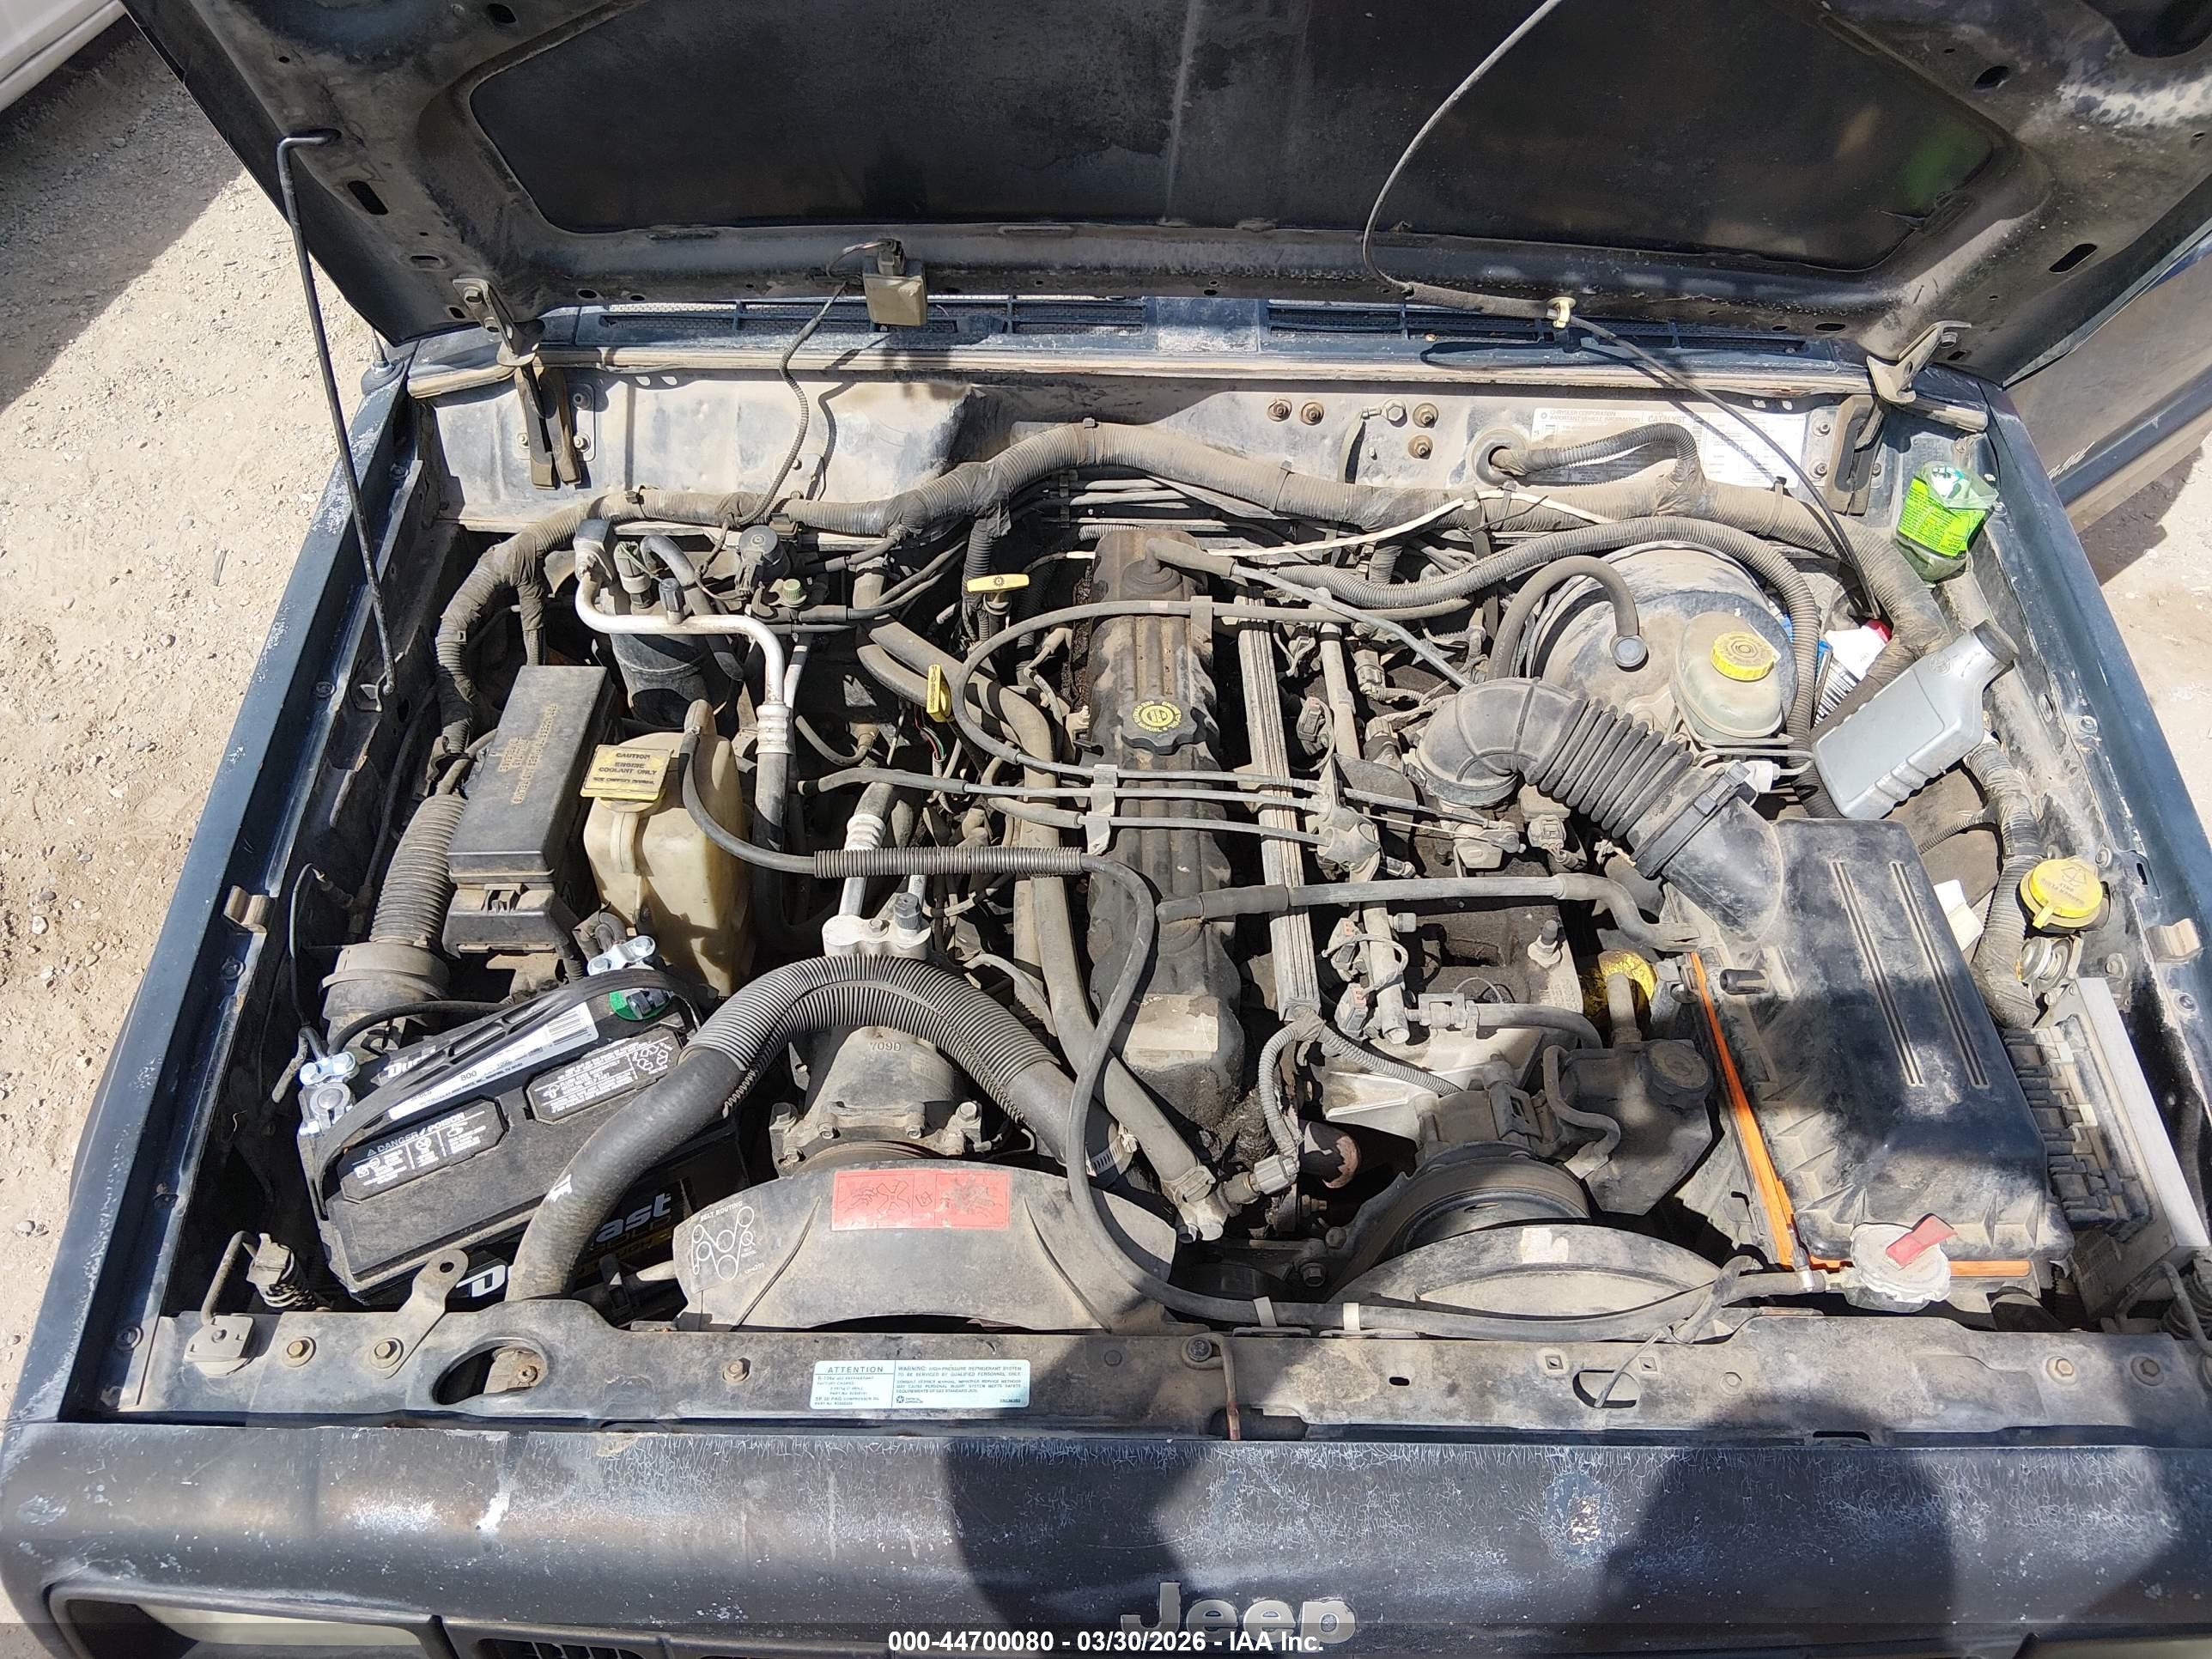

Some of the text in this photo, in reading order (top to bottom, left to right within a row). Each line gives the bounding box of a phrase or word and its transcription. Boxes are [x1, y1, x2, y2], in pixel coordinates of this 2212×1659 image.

[377, 1133, 420, 1153] DANGER
[428, 1112, 465, 1131] POISON
[700, 1200, 743, 1223] BELT ROUTING
[1120, 1580, 1358, 1644] Jeep
